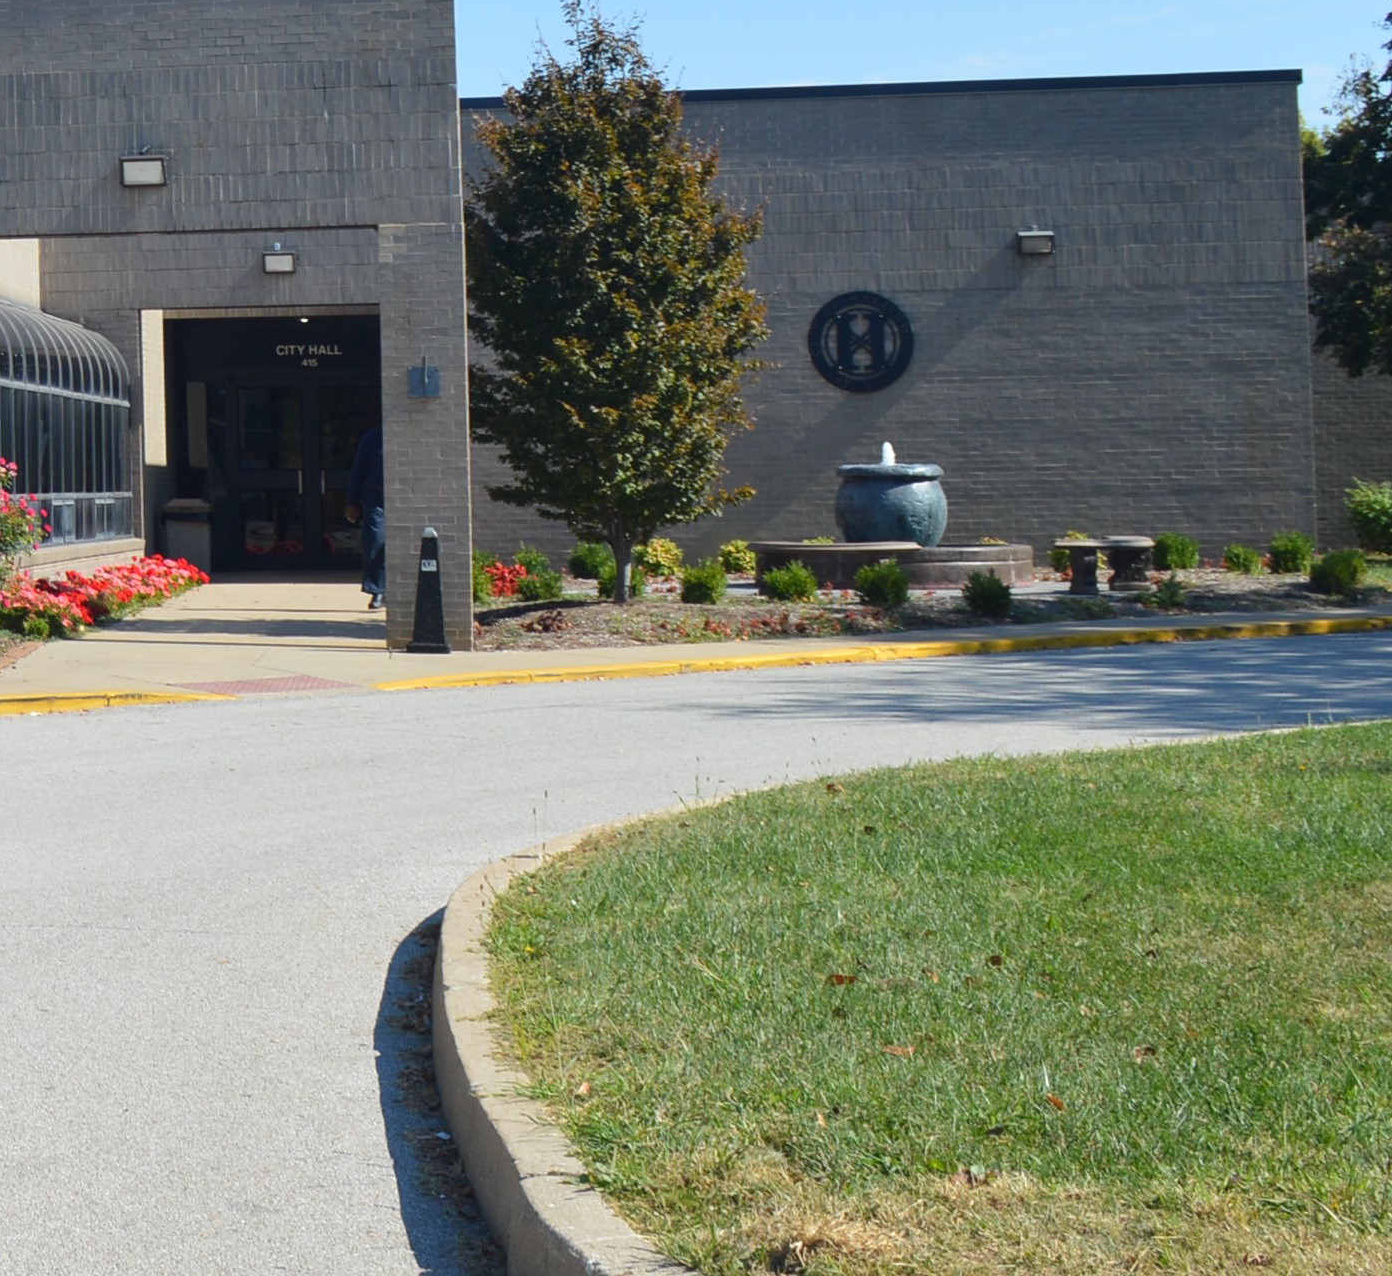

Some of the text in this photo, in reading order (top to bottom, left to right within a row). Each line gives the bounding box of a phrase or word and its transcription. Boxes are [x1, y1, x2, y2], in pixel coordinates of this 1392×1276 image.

[276, 344, 343, 356] CITY HALL
[301, 358, 318, 367] 415
